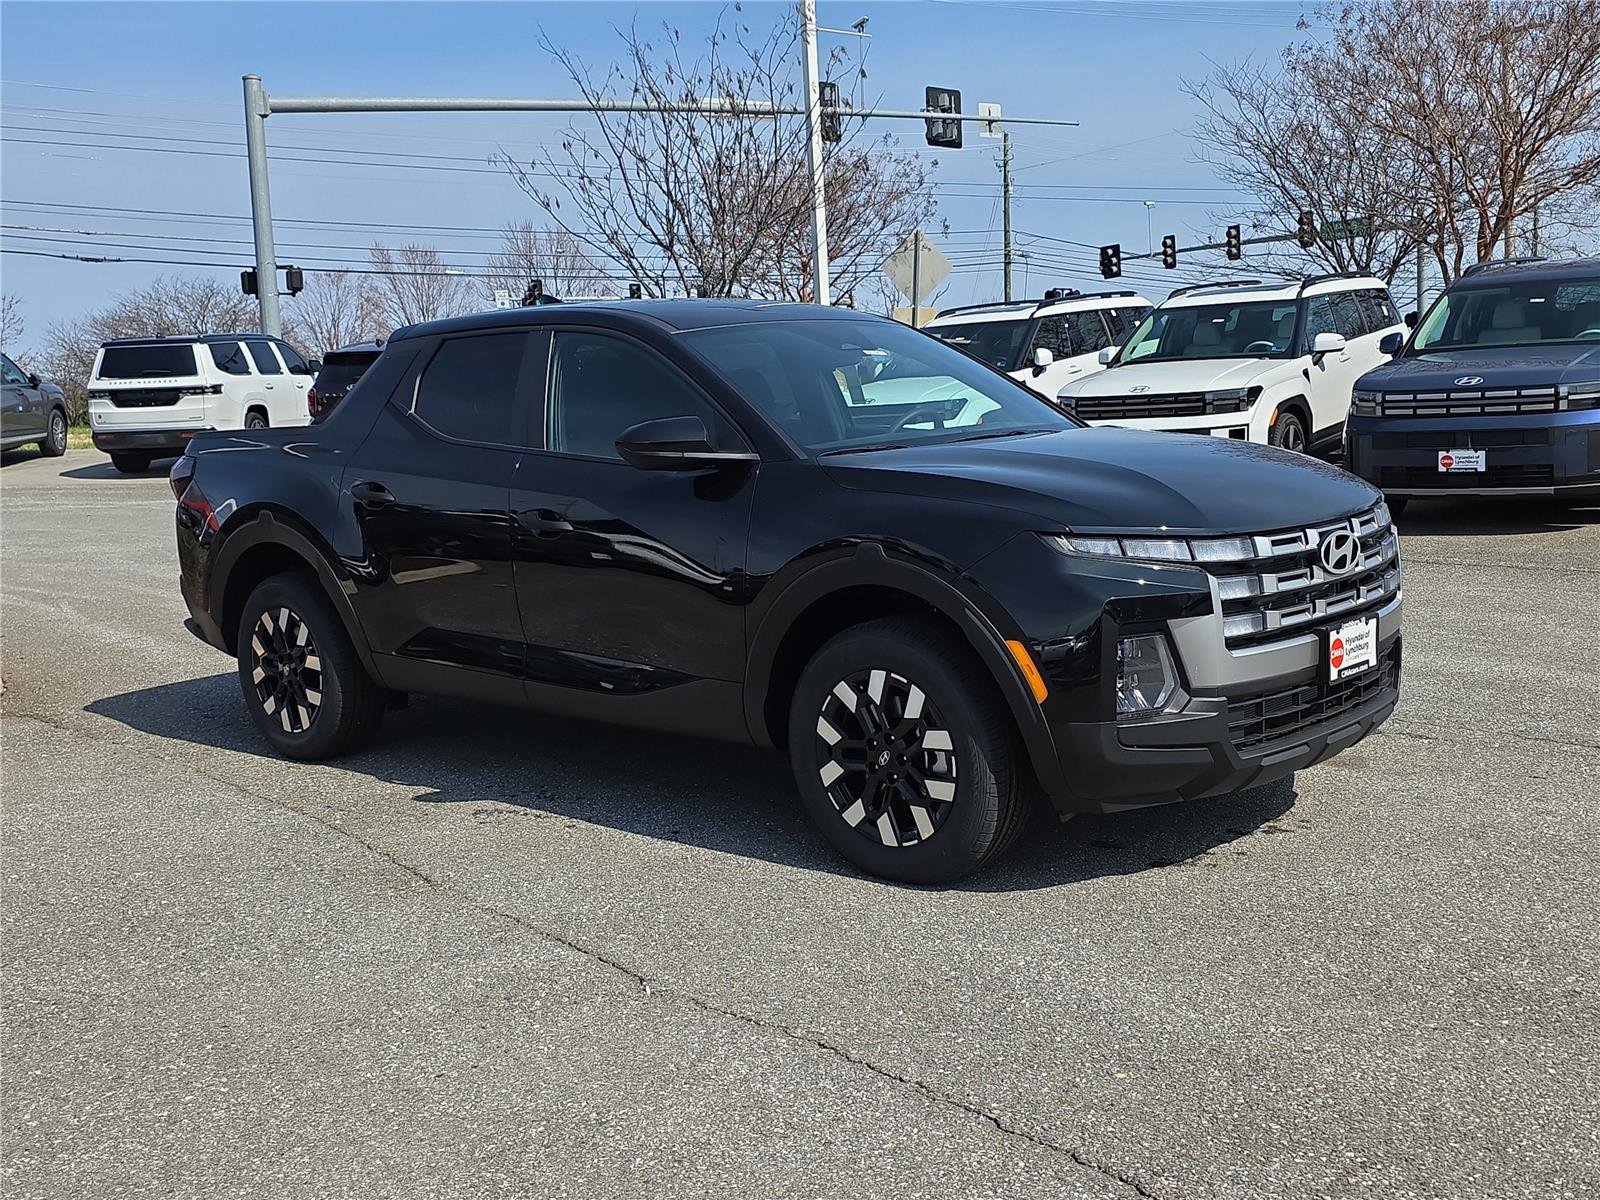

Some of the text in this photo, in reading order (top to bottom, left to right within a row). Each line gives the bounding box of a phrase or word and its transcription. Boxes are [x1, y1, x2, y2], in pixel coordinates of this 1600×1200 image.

[1345, 630, 1370, 646] Hyundai of
[1345, 641, 1369, 656] Lynchburg
